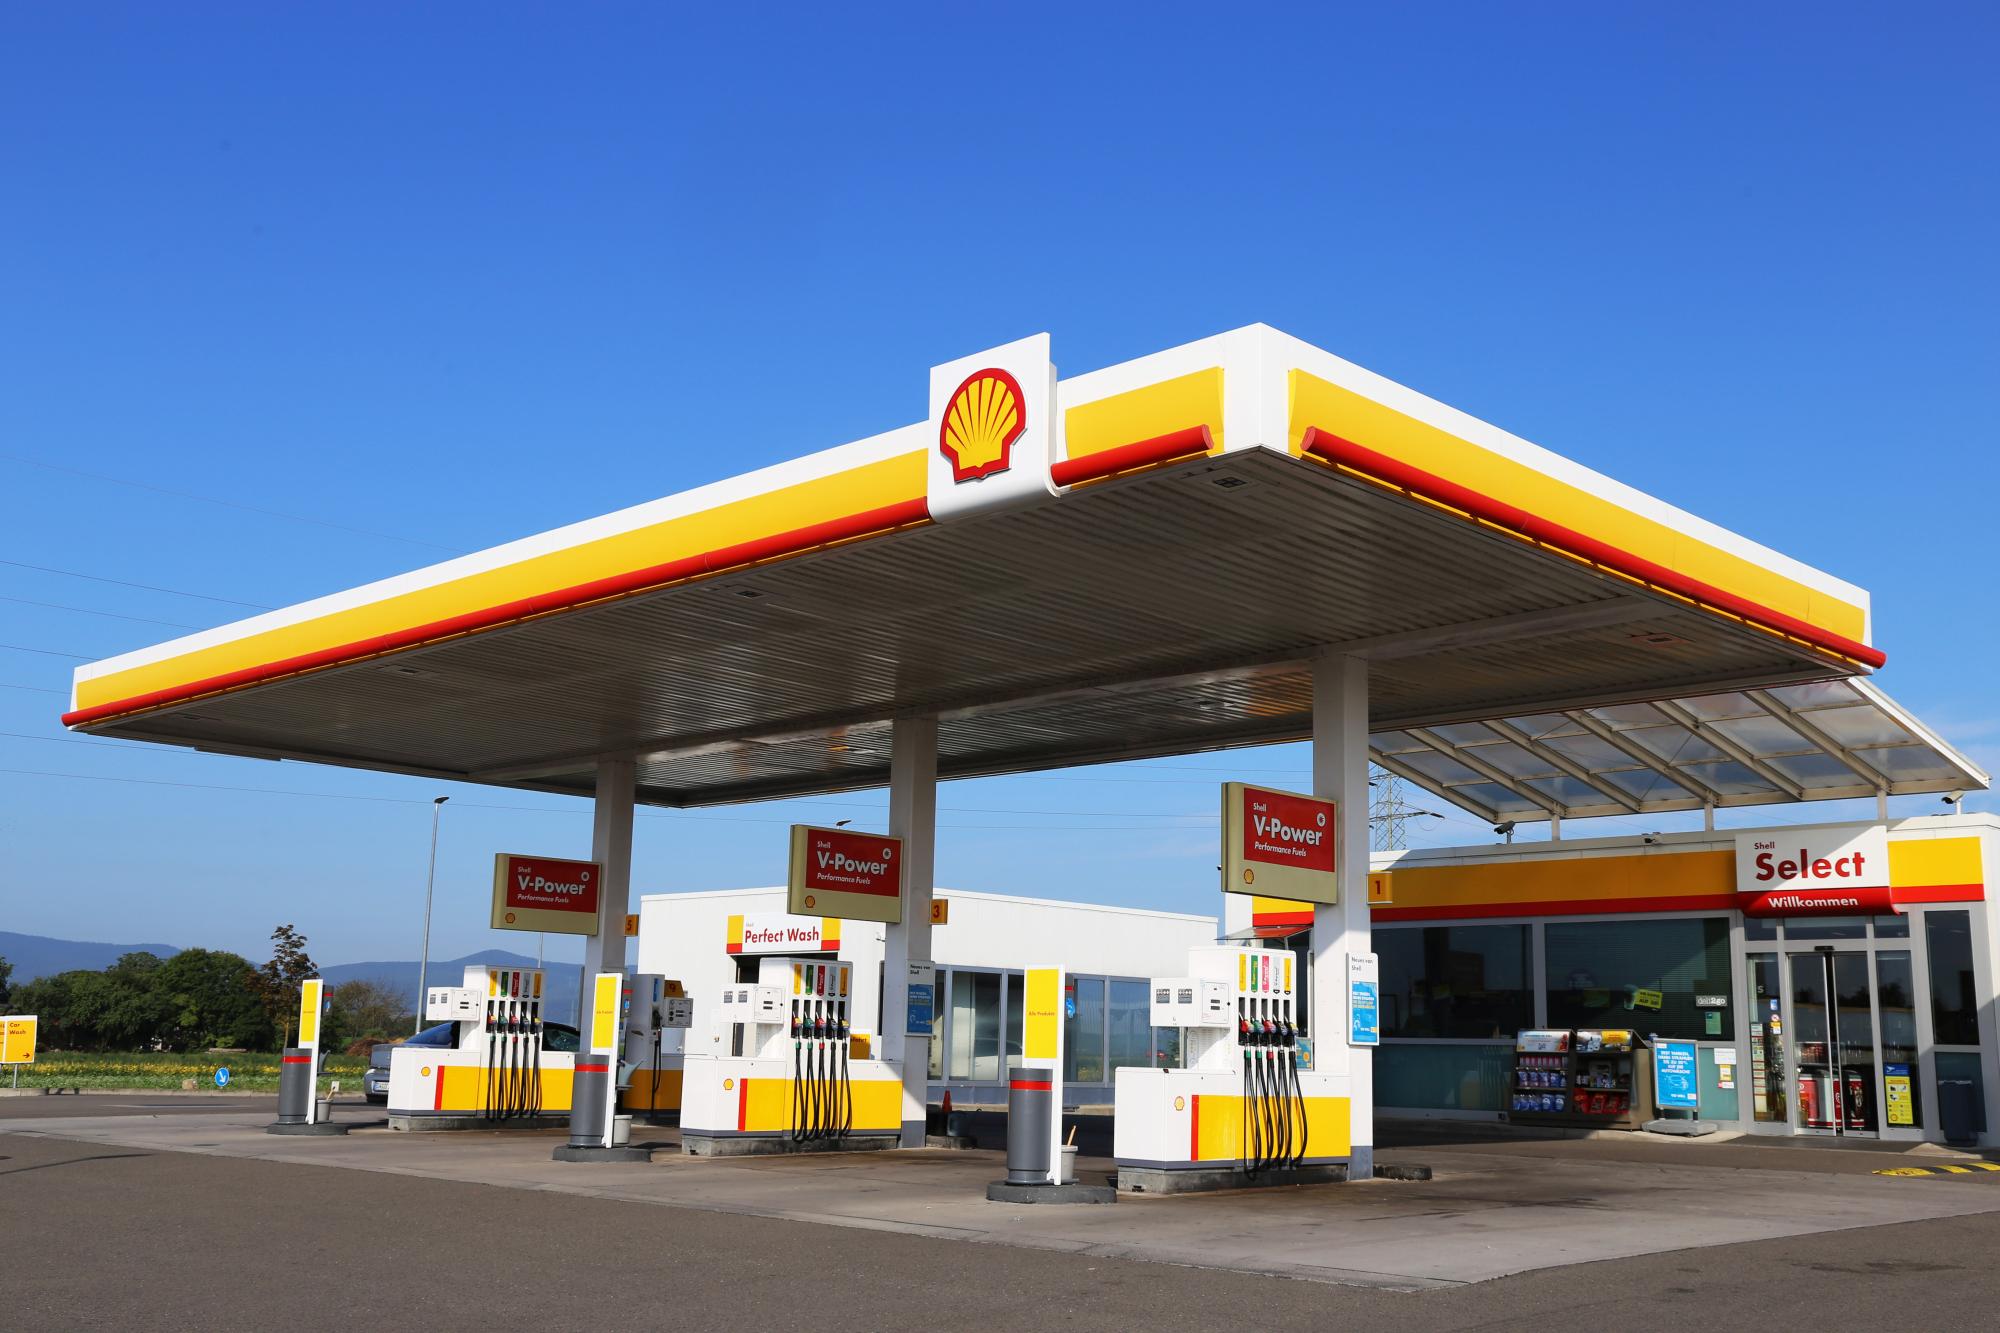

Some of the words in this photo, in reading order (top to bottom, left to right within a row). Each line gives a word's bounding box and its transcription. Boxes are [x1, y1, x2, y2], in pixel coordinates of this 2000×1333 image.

[1253, 802, 1267, 813] Shell
[1253, 814, 1323, 846] V-Power
[817, 841, 831, 849] Shell
[1254, 841, 1292, 855] Performance
[1292, 847, 1307, 857] Fuels
[1754, 841, 1775, 849] Shell
[817, 850, 888, 875] V-Power
[1756, 849, 1866, 881] Select
[518, 875, 586, 895] V-Power
[817, 872, 855, 883] Performance
[856, 877, 871, 885] Fuels
[1375, 880, 1381, 895] 1
[517, 893, 554, 903] Performance
[1768, 896, 1858, 908] Willkommen
[933, 904, 940, 918] 3
[627, 920, 632, 931] 5
[745, 928, 783, 943] Perfect
[787, 926, 819, 942] Wash
